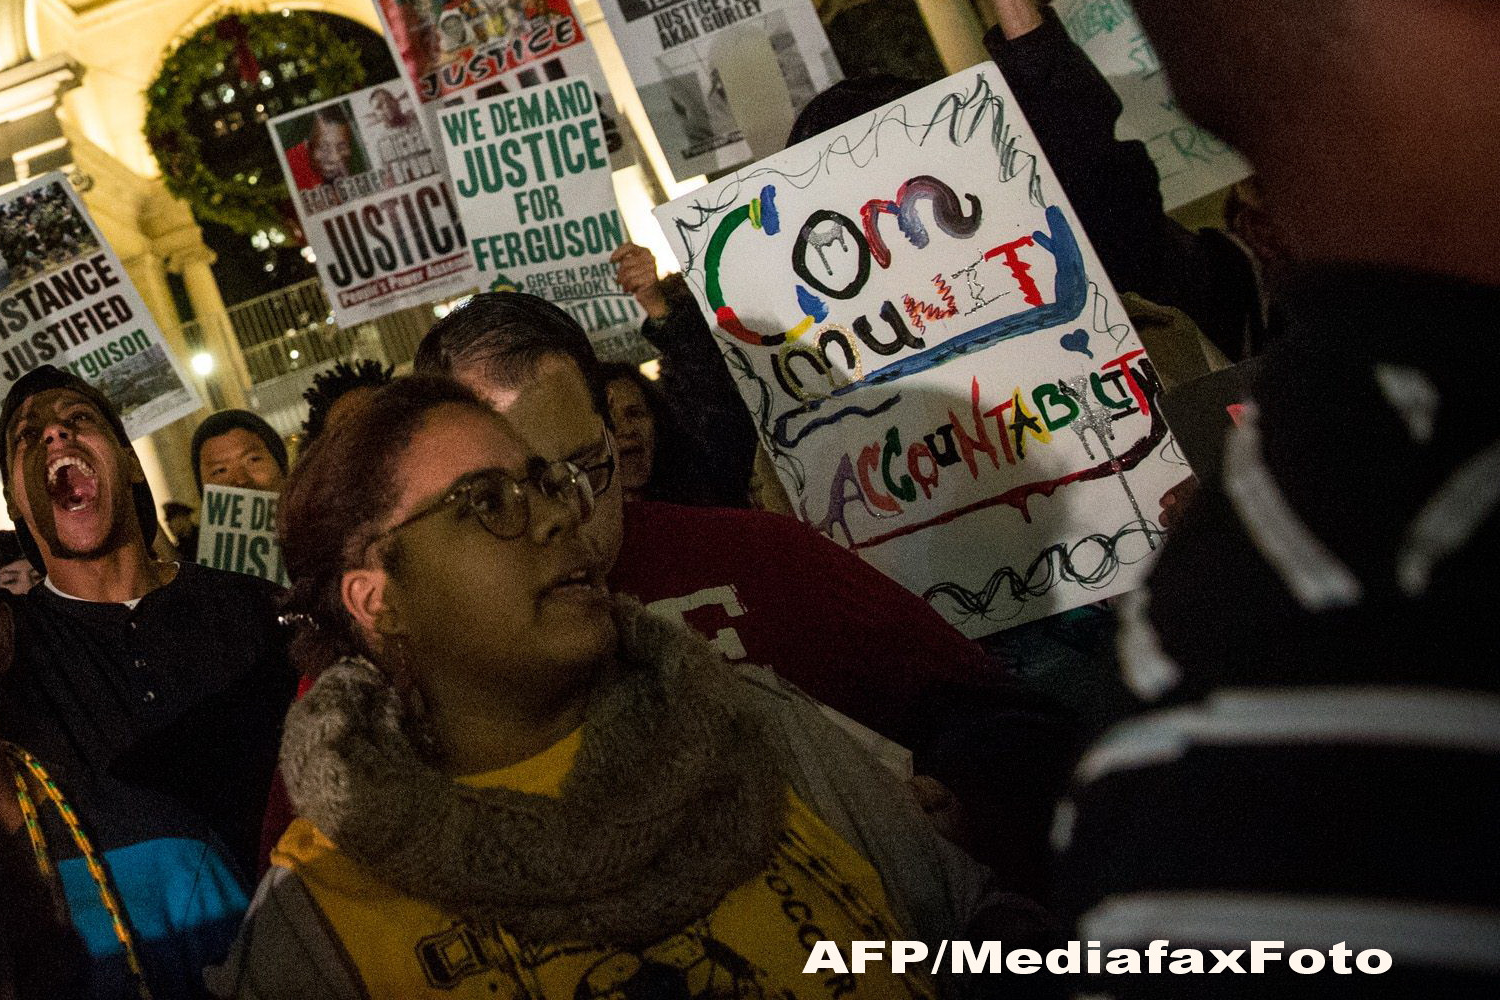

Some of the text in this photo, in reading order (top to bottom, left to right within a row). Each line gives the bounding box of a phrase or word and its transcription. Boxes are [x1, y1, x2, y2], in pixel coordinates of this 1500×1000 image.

[420, 18, 574, 98] JUSTICE
[657, 19, 700, 50] AKAI
[442, 107, 486, 147] WE
[489, 79, 594, 137] DEMAND
[456, 119, 607, 198] JUSTICE
[513, 185, 564, 225] FOR
[471, 209, 623, 271] FERGUSON
[526, 260, 620, 289] GREEN PART
[3, 294, 133, 381] JUSTIFIED
[207, 491, 244, 528] WE
